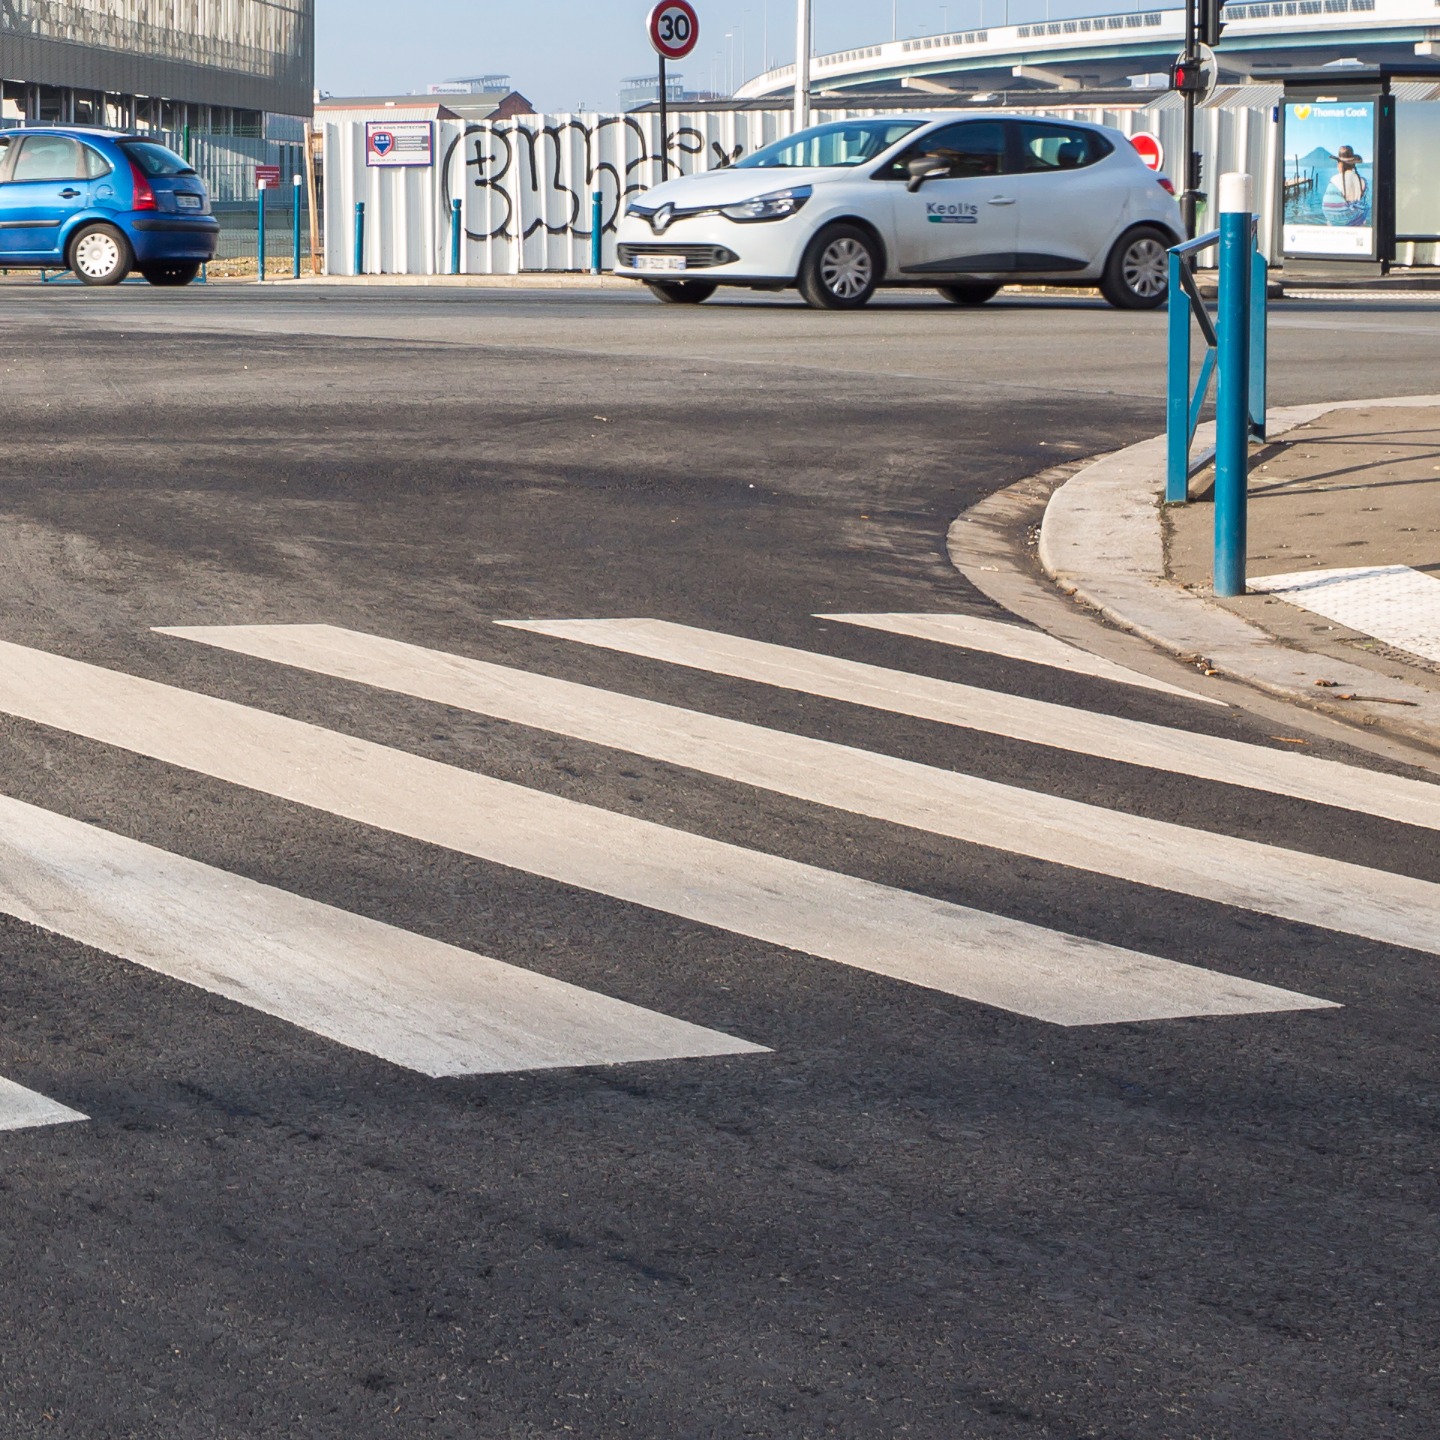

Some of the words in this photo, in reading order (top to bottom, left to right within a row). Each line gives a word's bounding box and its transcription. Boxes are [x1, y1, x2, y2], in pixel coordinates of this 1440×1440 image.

[660, 14, 690, 41] 30
[1313, 107, 1345, 117] Thomas
[1346, 107, 1367, 117] Cook
[926, 202, 978, 215] Keolis
